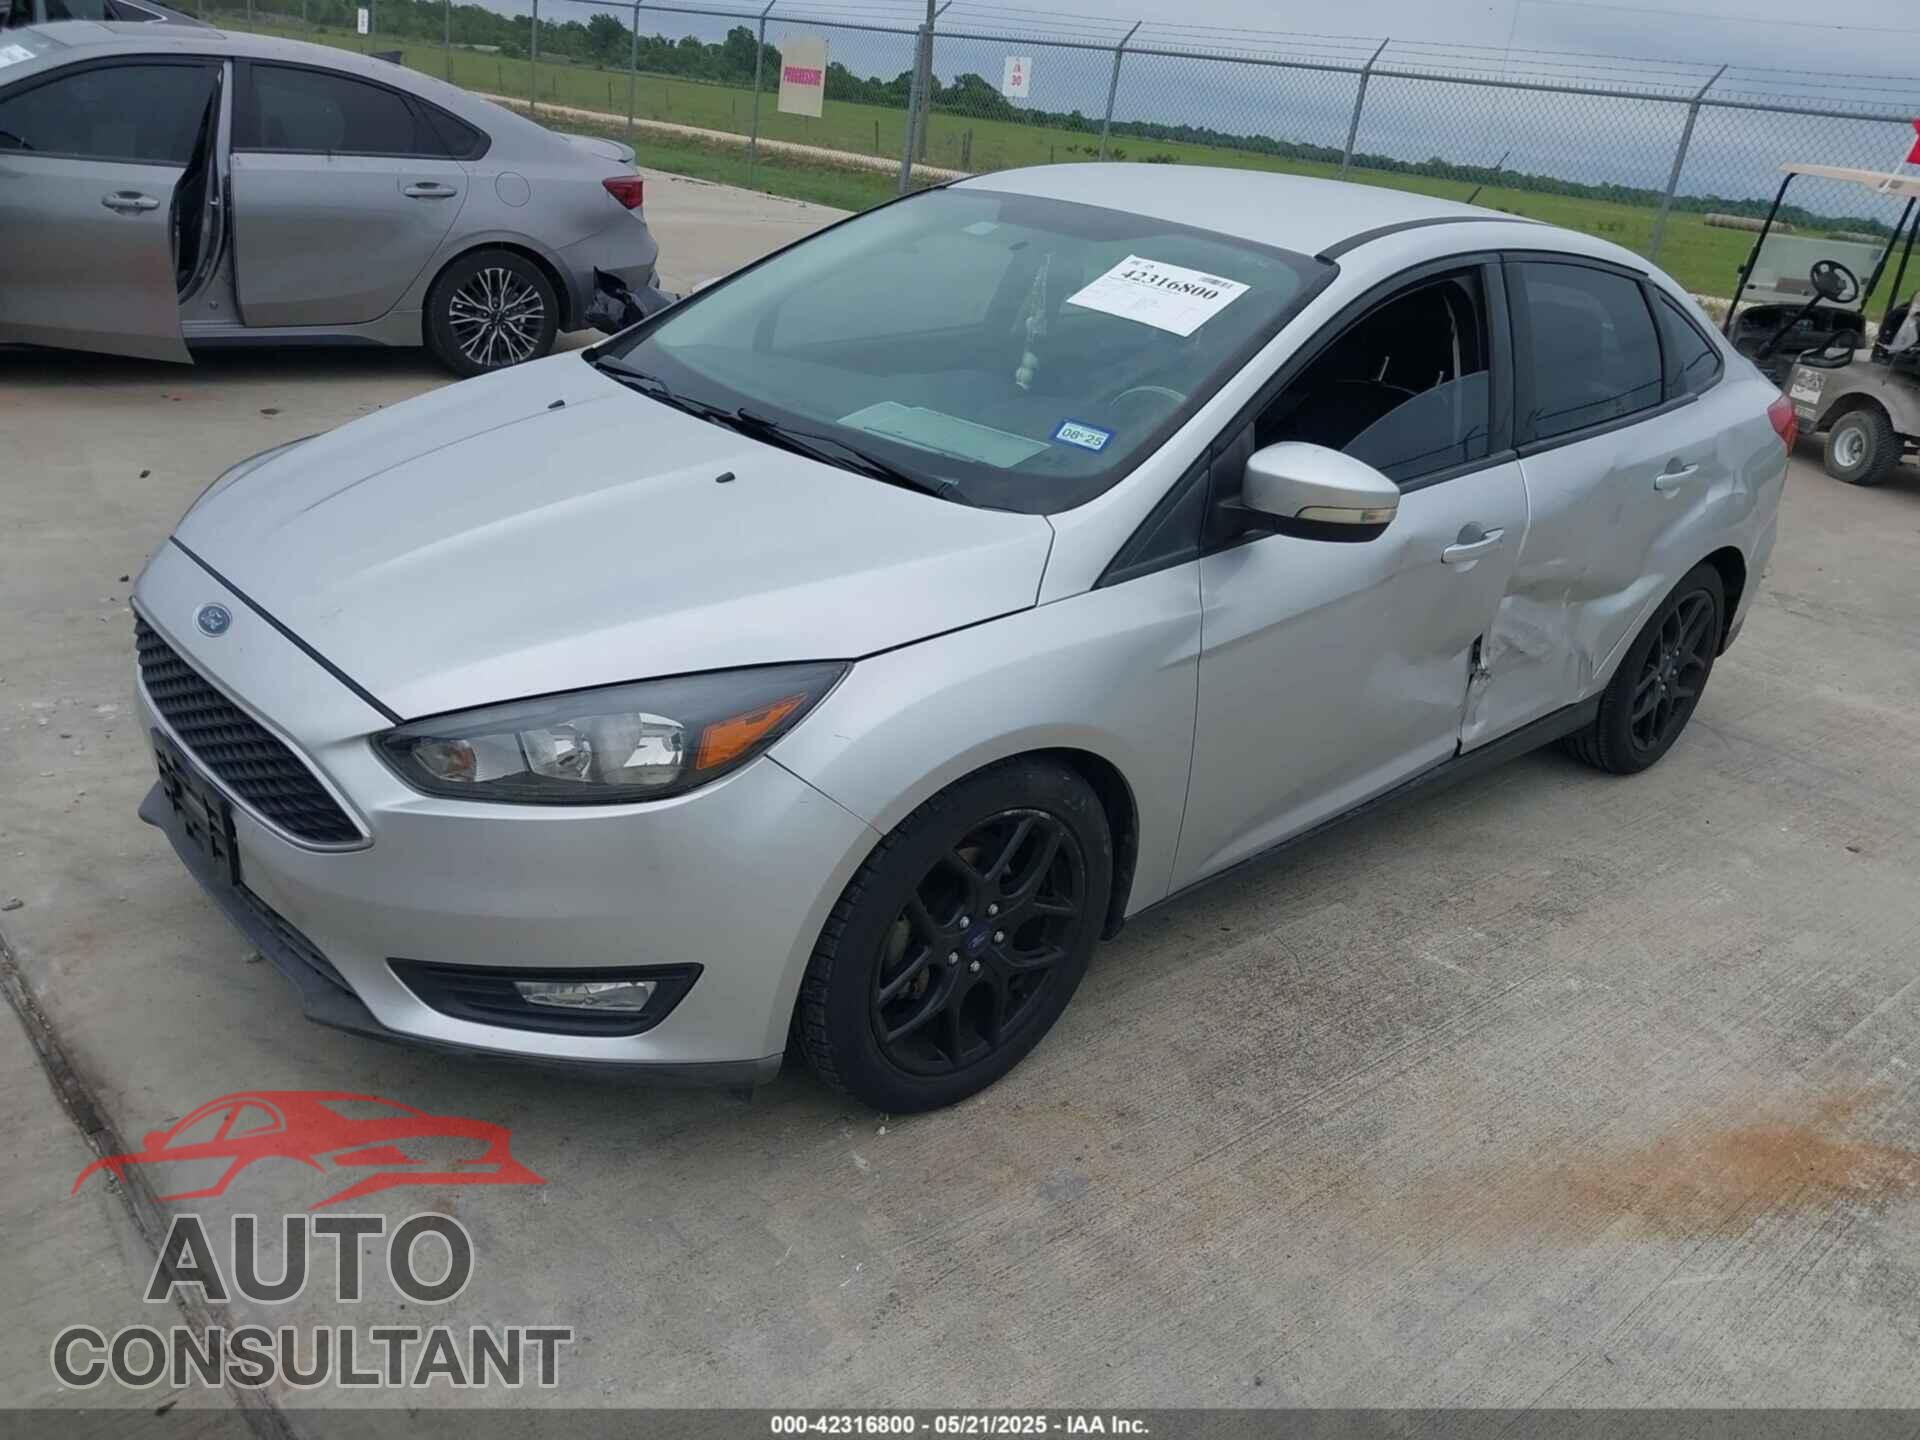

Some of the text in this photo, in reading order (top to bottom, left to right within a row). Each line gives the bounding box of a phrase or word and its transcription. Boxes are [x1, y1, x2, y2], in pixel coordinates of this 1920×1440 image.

[1120, 269, 1219, 300] 42316800
[1062, 428, 1103, 447] 08 25
